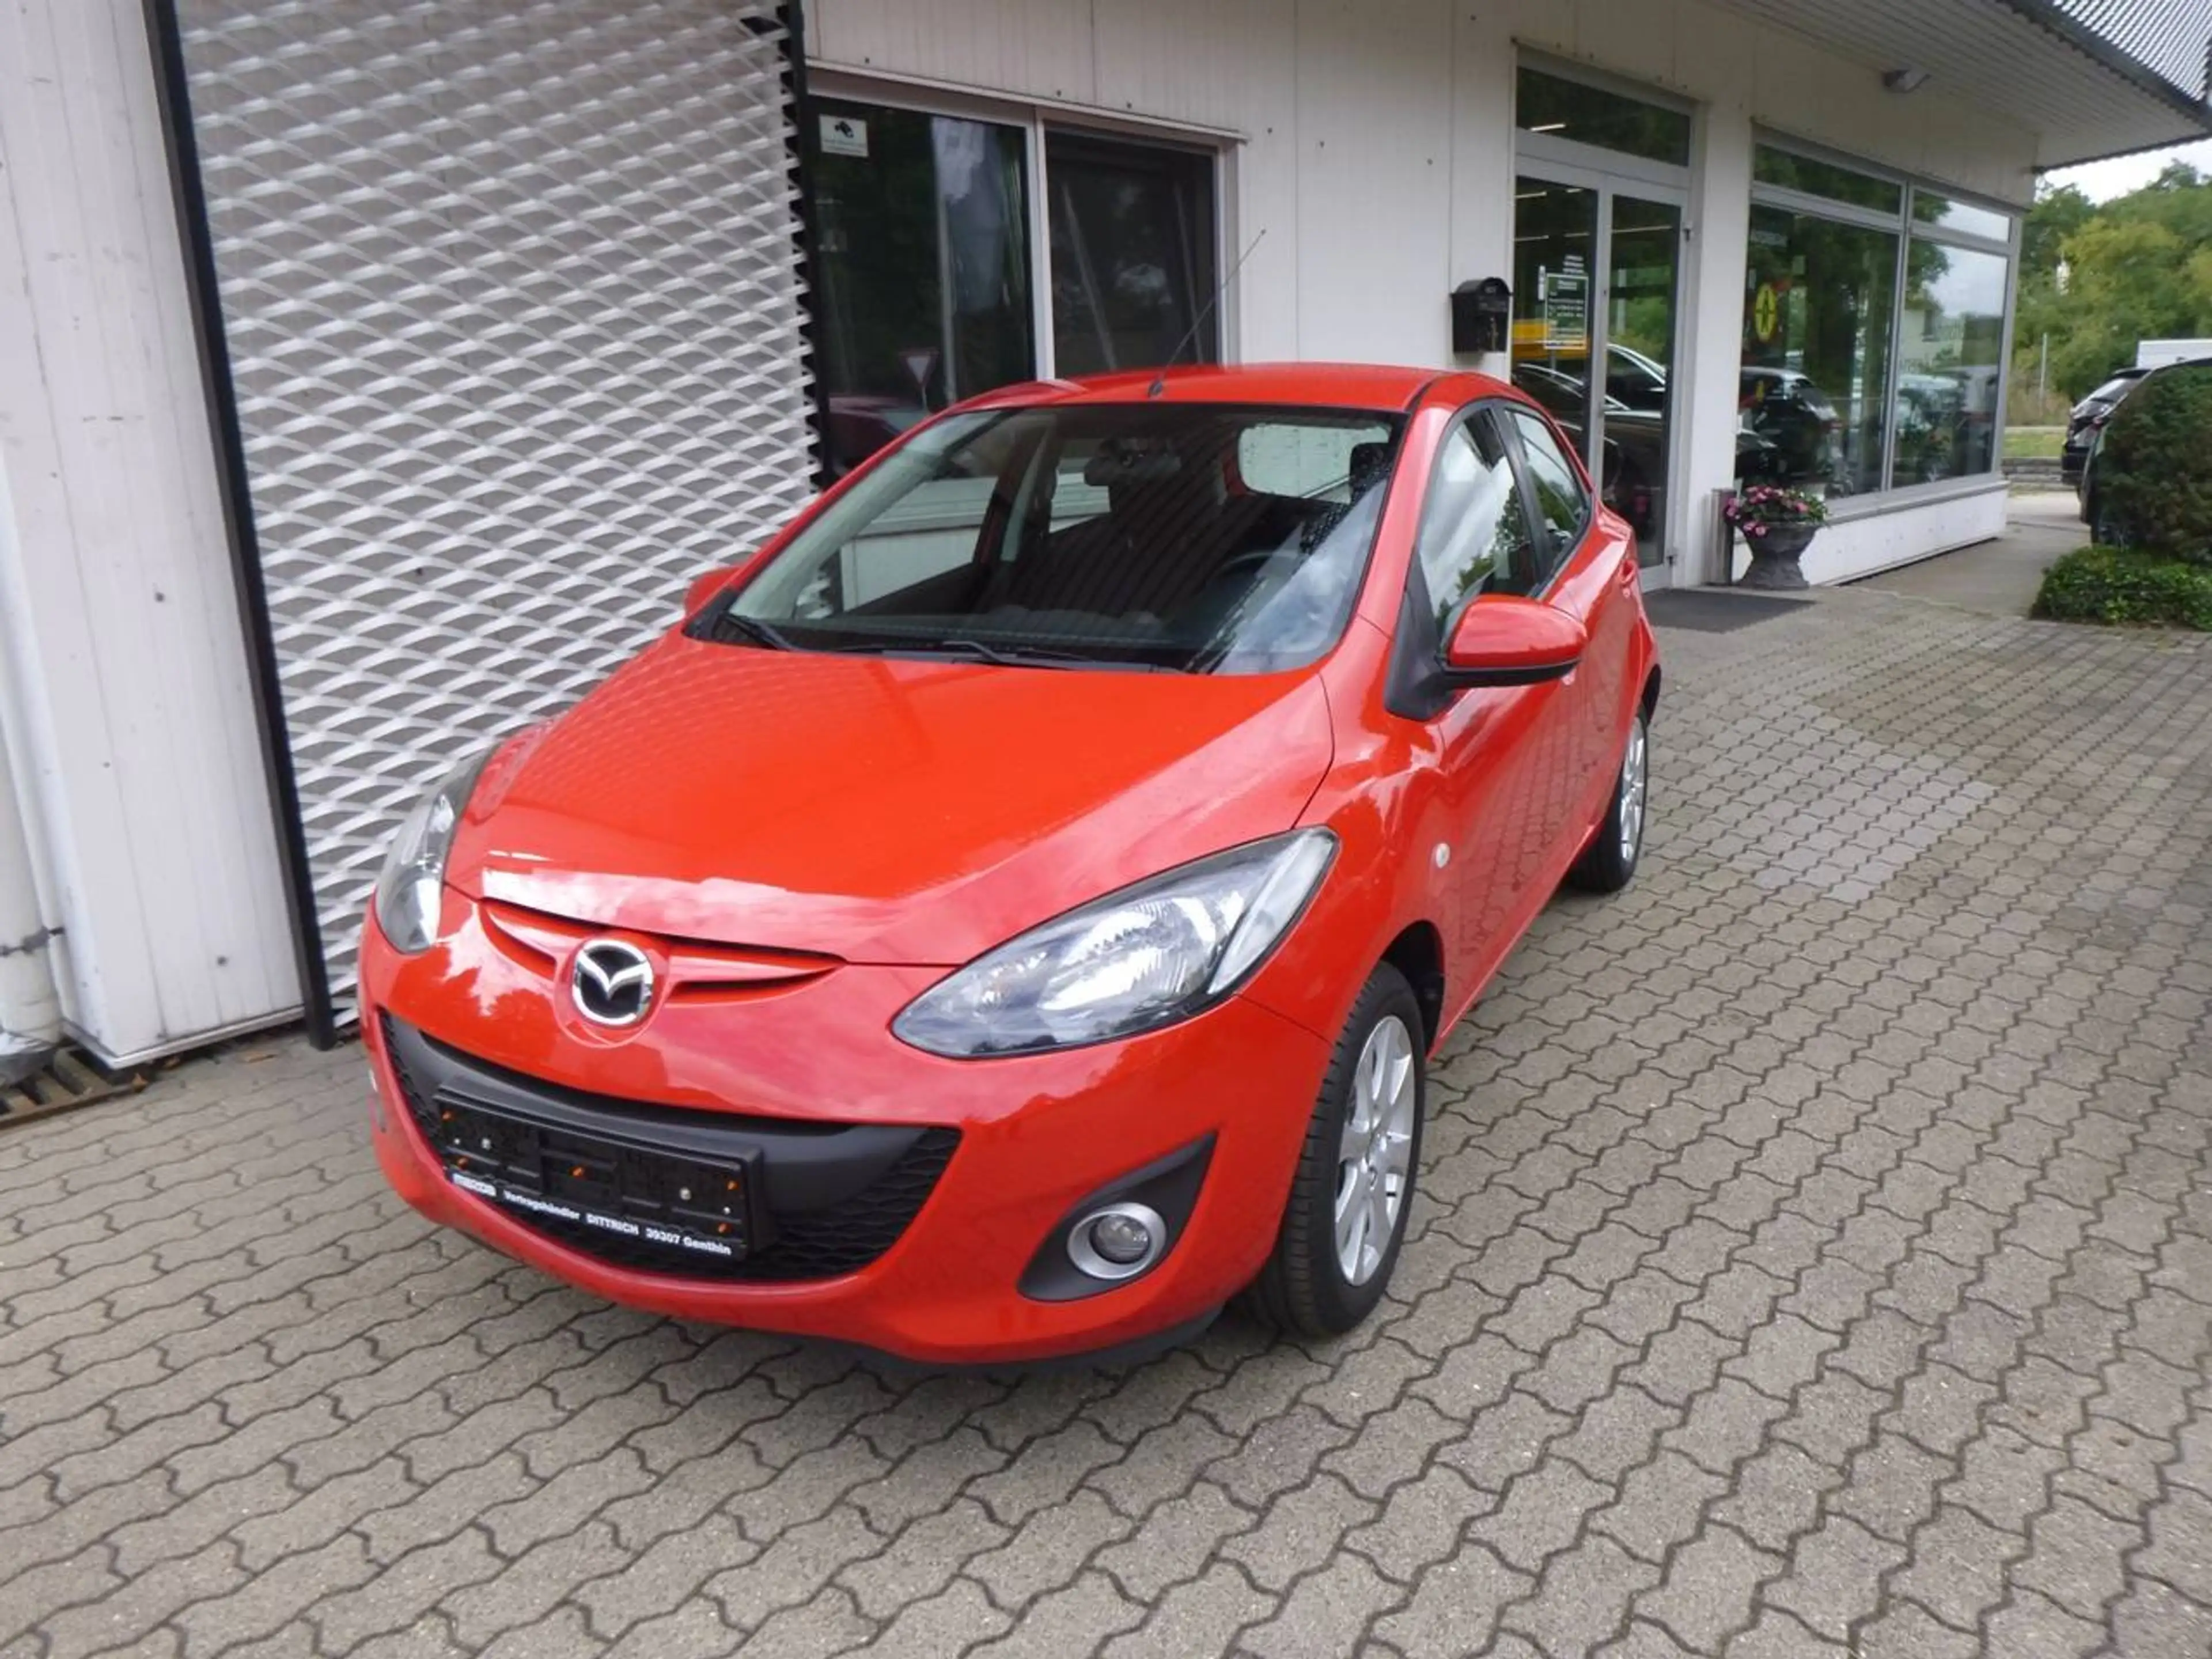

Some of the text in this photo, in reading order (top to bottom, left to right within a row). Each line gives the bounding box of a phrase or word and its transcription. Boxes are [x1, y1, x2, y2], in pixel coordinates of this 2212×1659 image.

[586, 1213, 639, 1236] DITTRICH
[645, 1226, 681, 1244] 39307
[683, 1236, 732, 1256] Genthin
